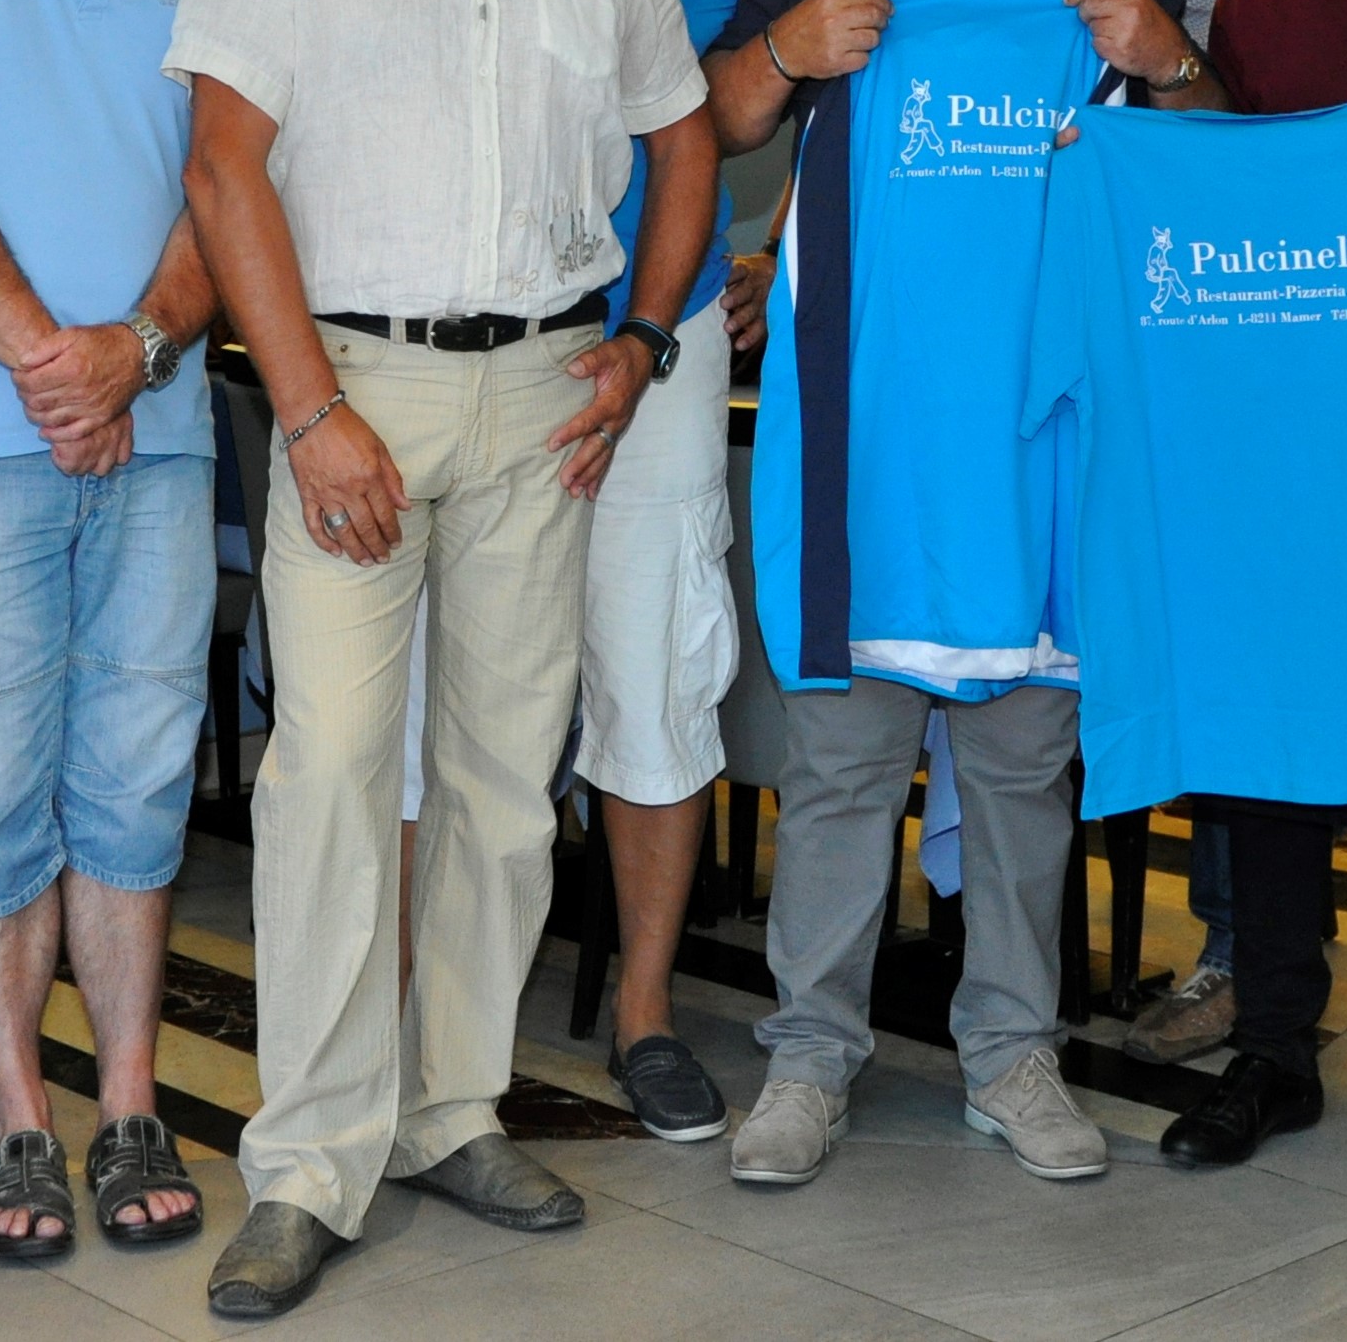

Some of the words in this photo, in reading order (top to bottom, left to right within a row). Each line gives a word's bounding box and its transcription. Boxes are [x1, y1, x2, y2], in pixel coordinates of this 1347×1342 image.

[951, 140, 1050, 156] Restaurant-P
[907, 167, 935, 177] route
[991, 166, 1029, 177] L-8211
[1196, 284, 1346, 303] Restaurant-Pizzeria
[1158, 316, 1185, 326] route
[1238, 312, 1276, 324] L-8211
[1280, 311, 1322, 323] Mamer
